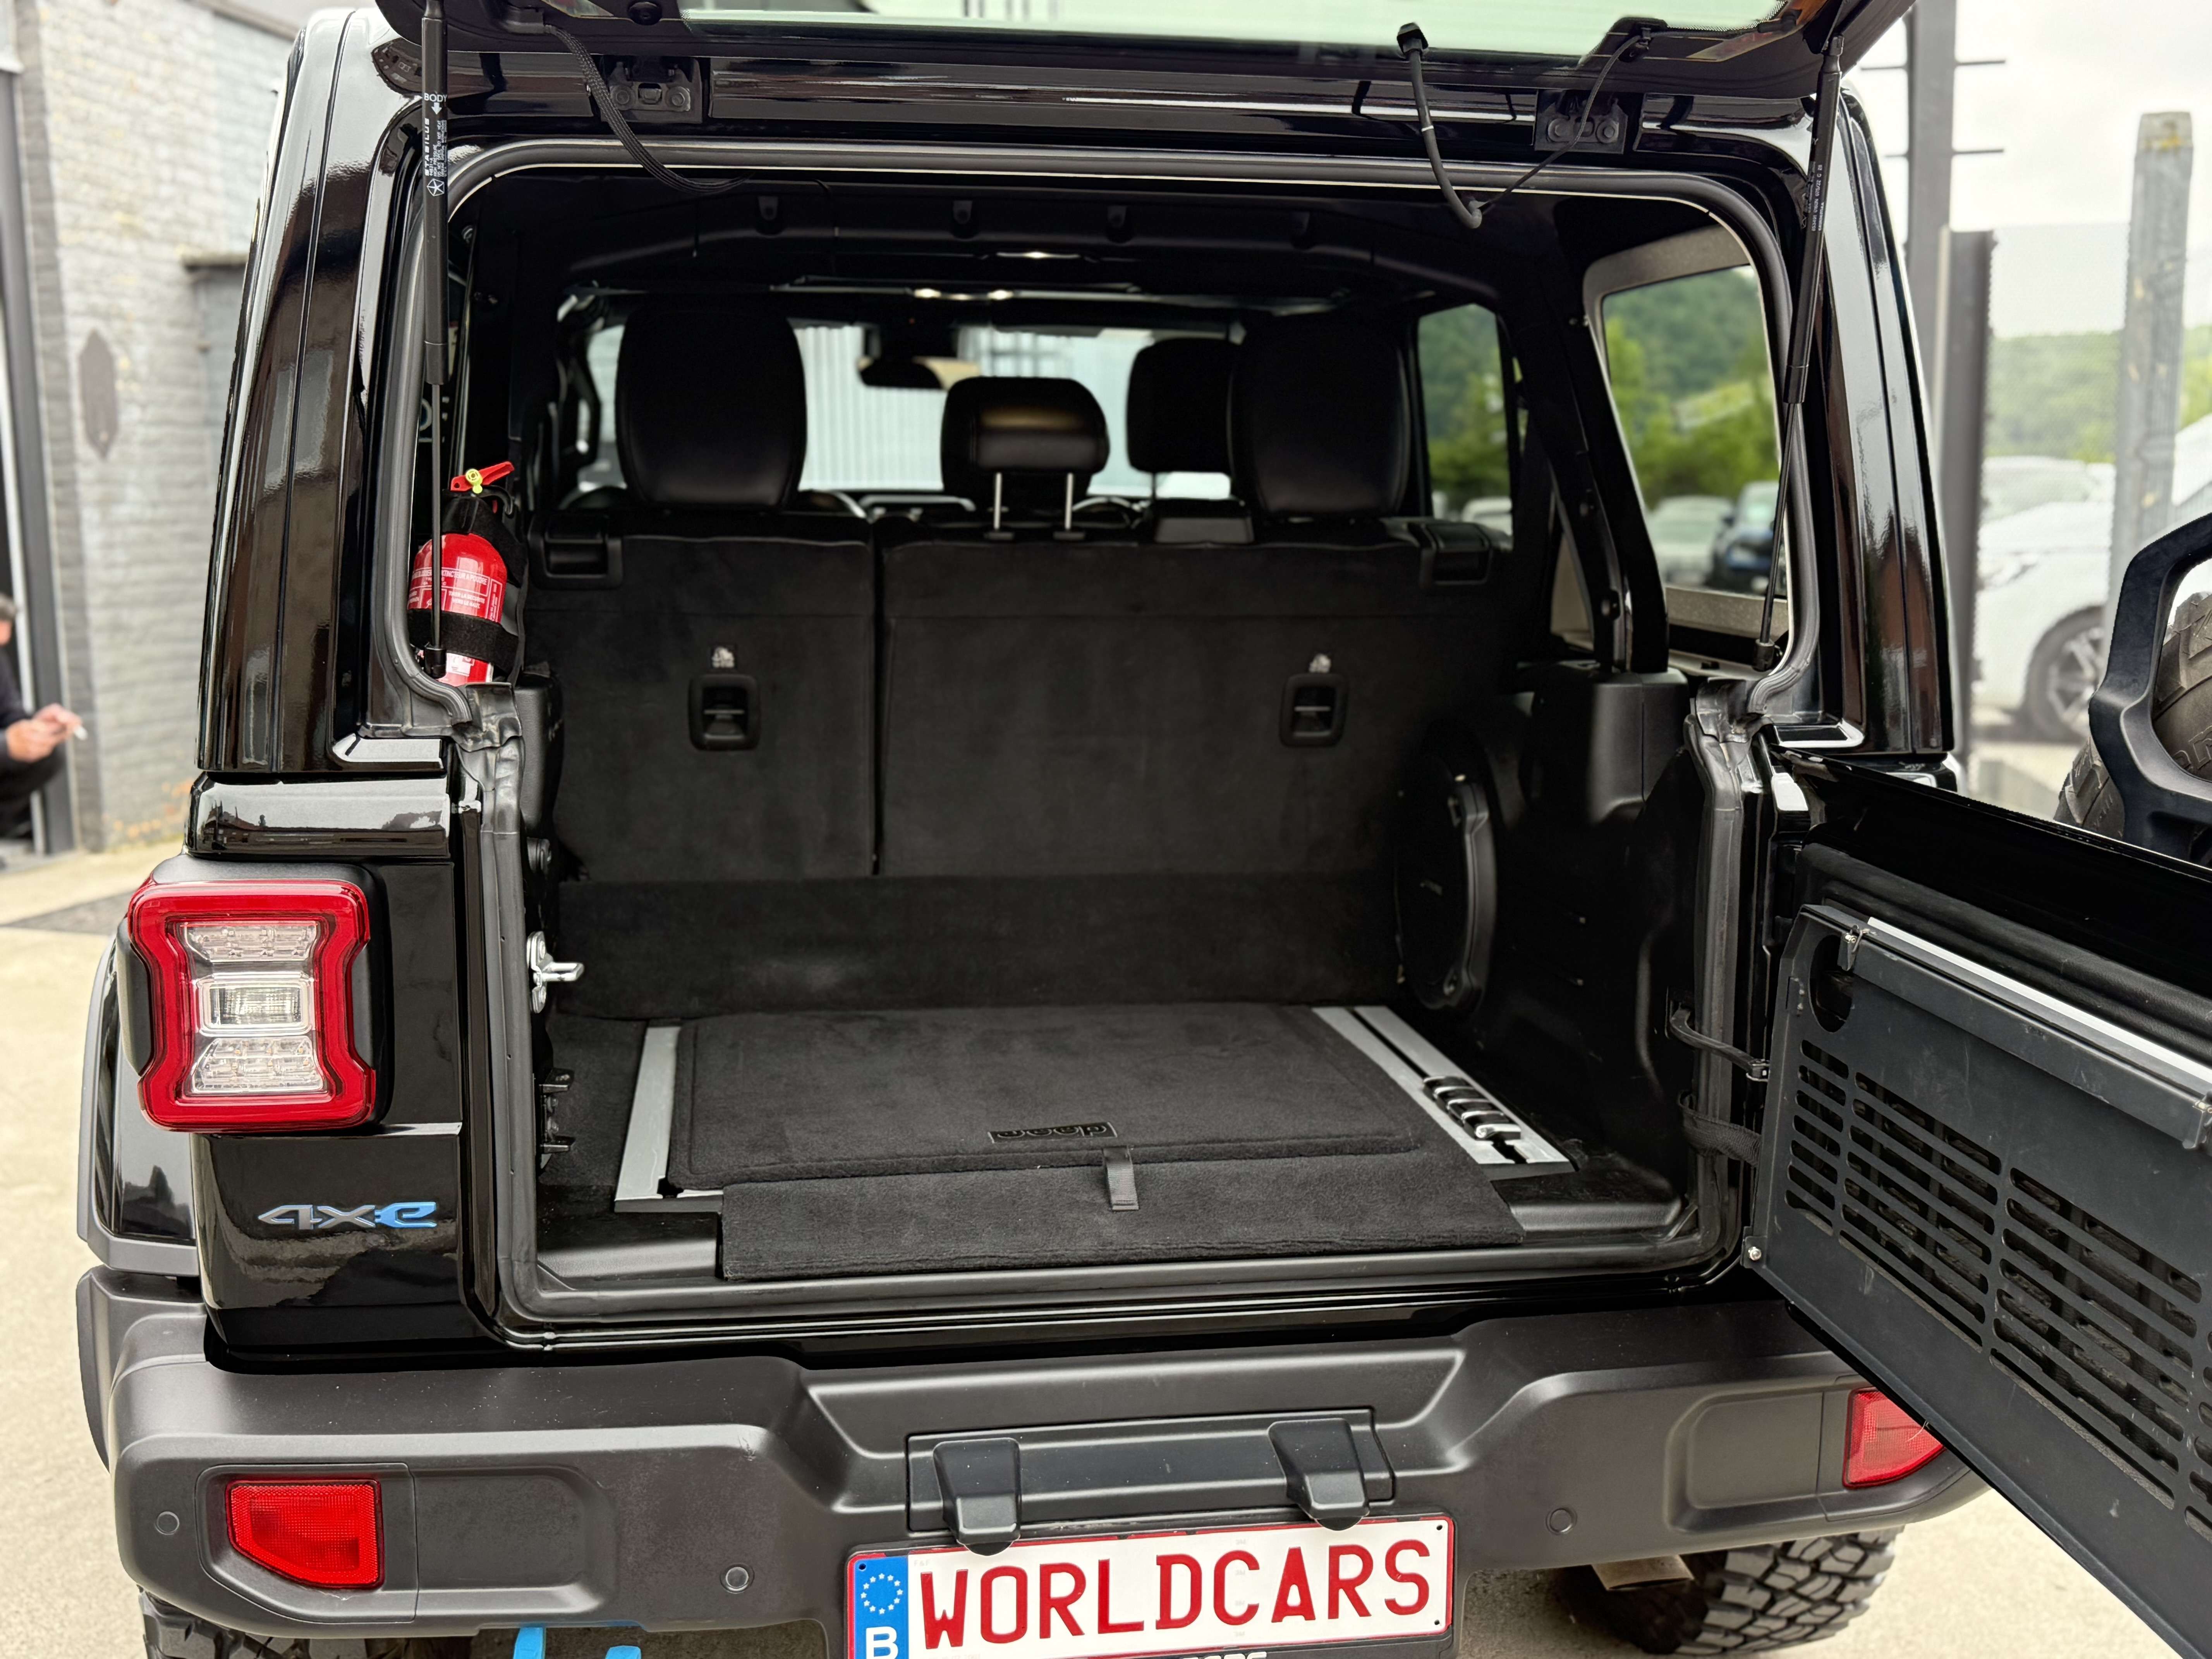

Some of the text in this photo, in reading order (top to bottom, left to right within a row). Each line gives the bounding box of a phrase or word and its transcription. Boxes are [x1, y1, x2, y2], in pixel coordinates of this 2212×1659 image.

[424, 93, 447, 102] BODY
[921, 1539, 1430, 1649] WORLDCARS
[866, 1626, 899, 1659] B
